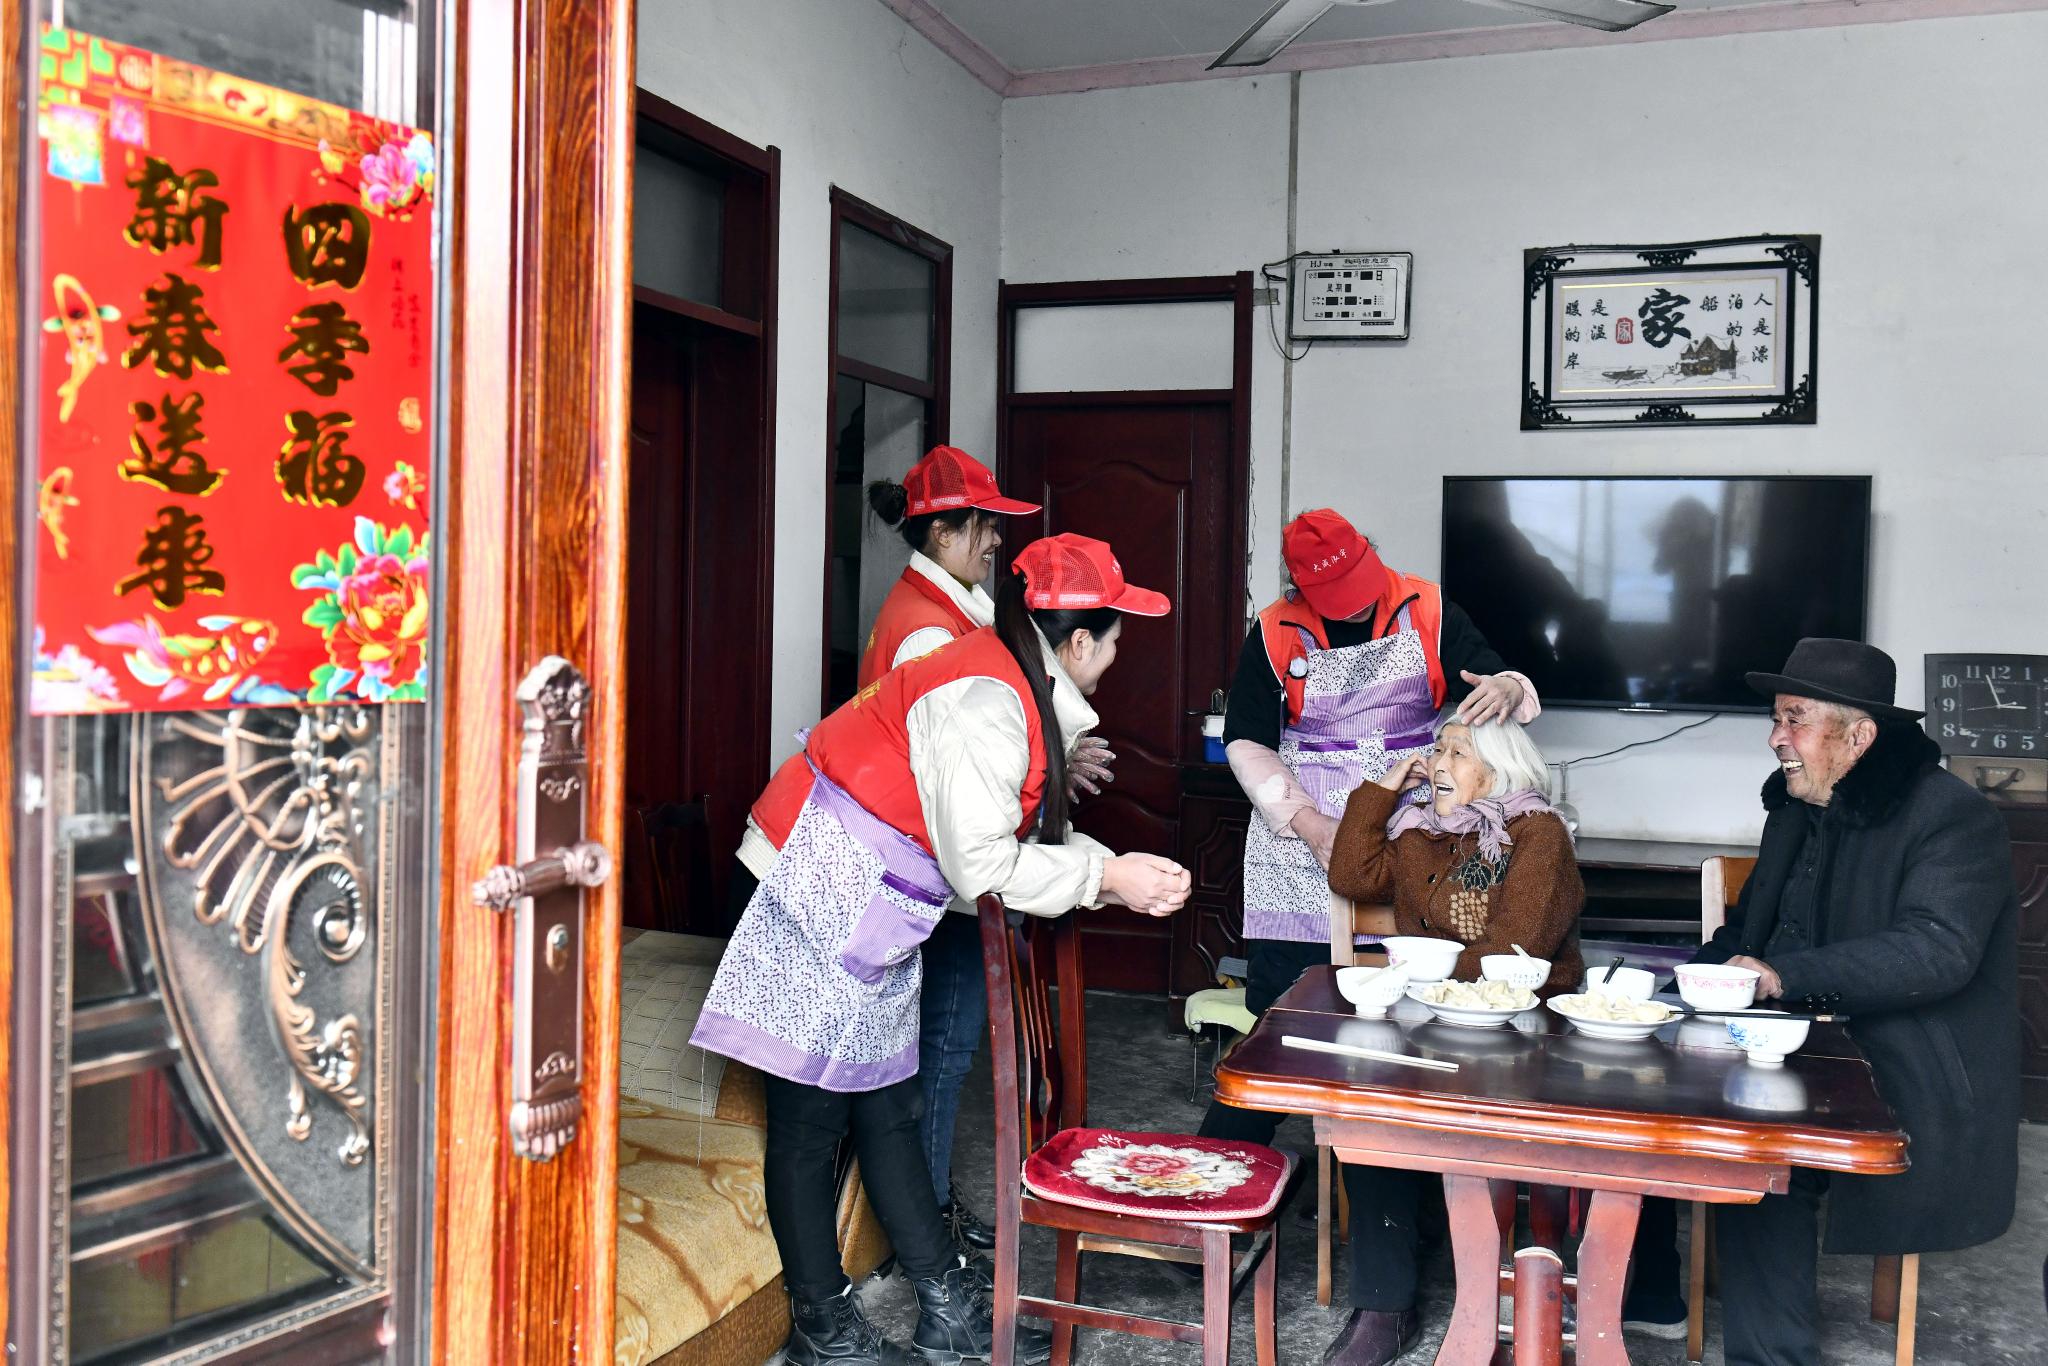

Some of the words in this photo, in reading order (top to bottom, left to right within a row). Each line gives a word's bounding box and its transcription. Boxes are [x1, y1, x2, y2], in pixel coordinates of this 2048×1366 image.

[1310, 260, 1322, 268] HJ
[1326, 283, 1343, 293] 星期
[1699, 295, 1719, 312] 船
[1590, 298, 1609, 341] 是温
[1638, 288, 1692, 348] 家
[1726, 293, 1743, 337] 泊的
[1564, 299, 1582, 370] 暖的岸
[1751, 291, 1773, 363] 人是漂
[273, 202, 372, 508] 四季福
[1966, 665, 1981, 679] 11
[1990, 665, 2011, 680] 12
[2024, 667, 2031, 680] 1
[1941, 674, 1958, 689] 10
[1942, 697, 1955, 712] 9
[1943, 723, 1955, 737] 8
[1970, 733, 1980, 748] 7
[1993, 734, 2007, 749] 6
[2021, 736, 2035, 751] 5
